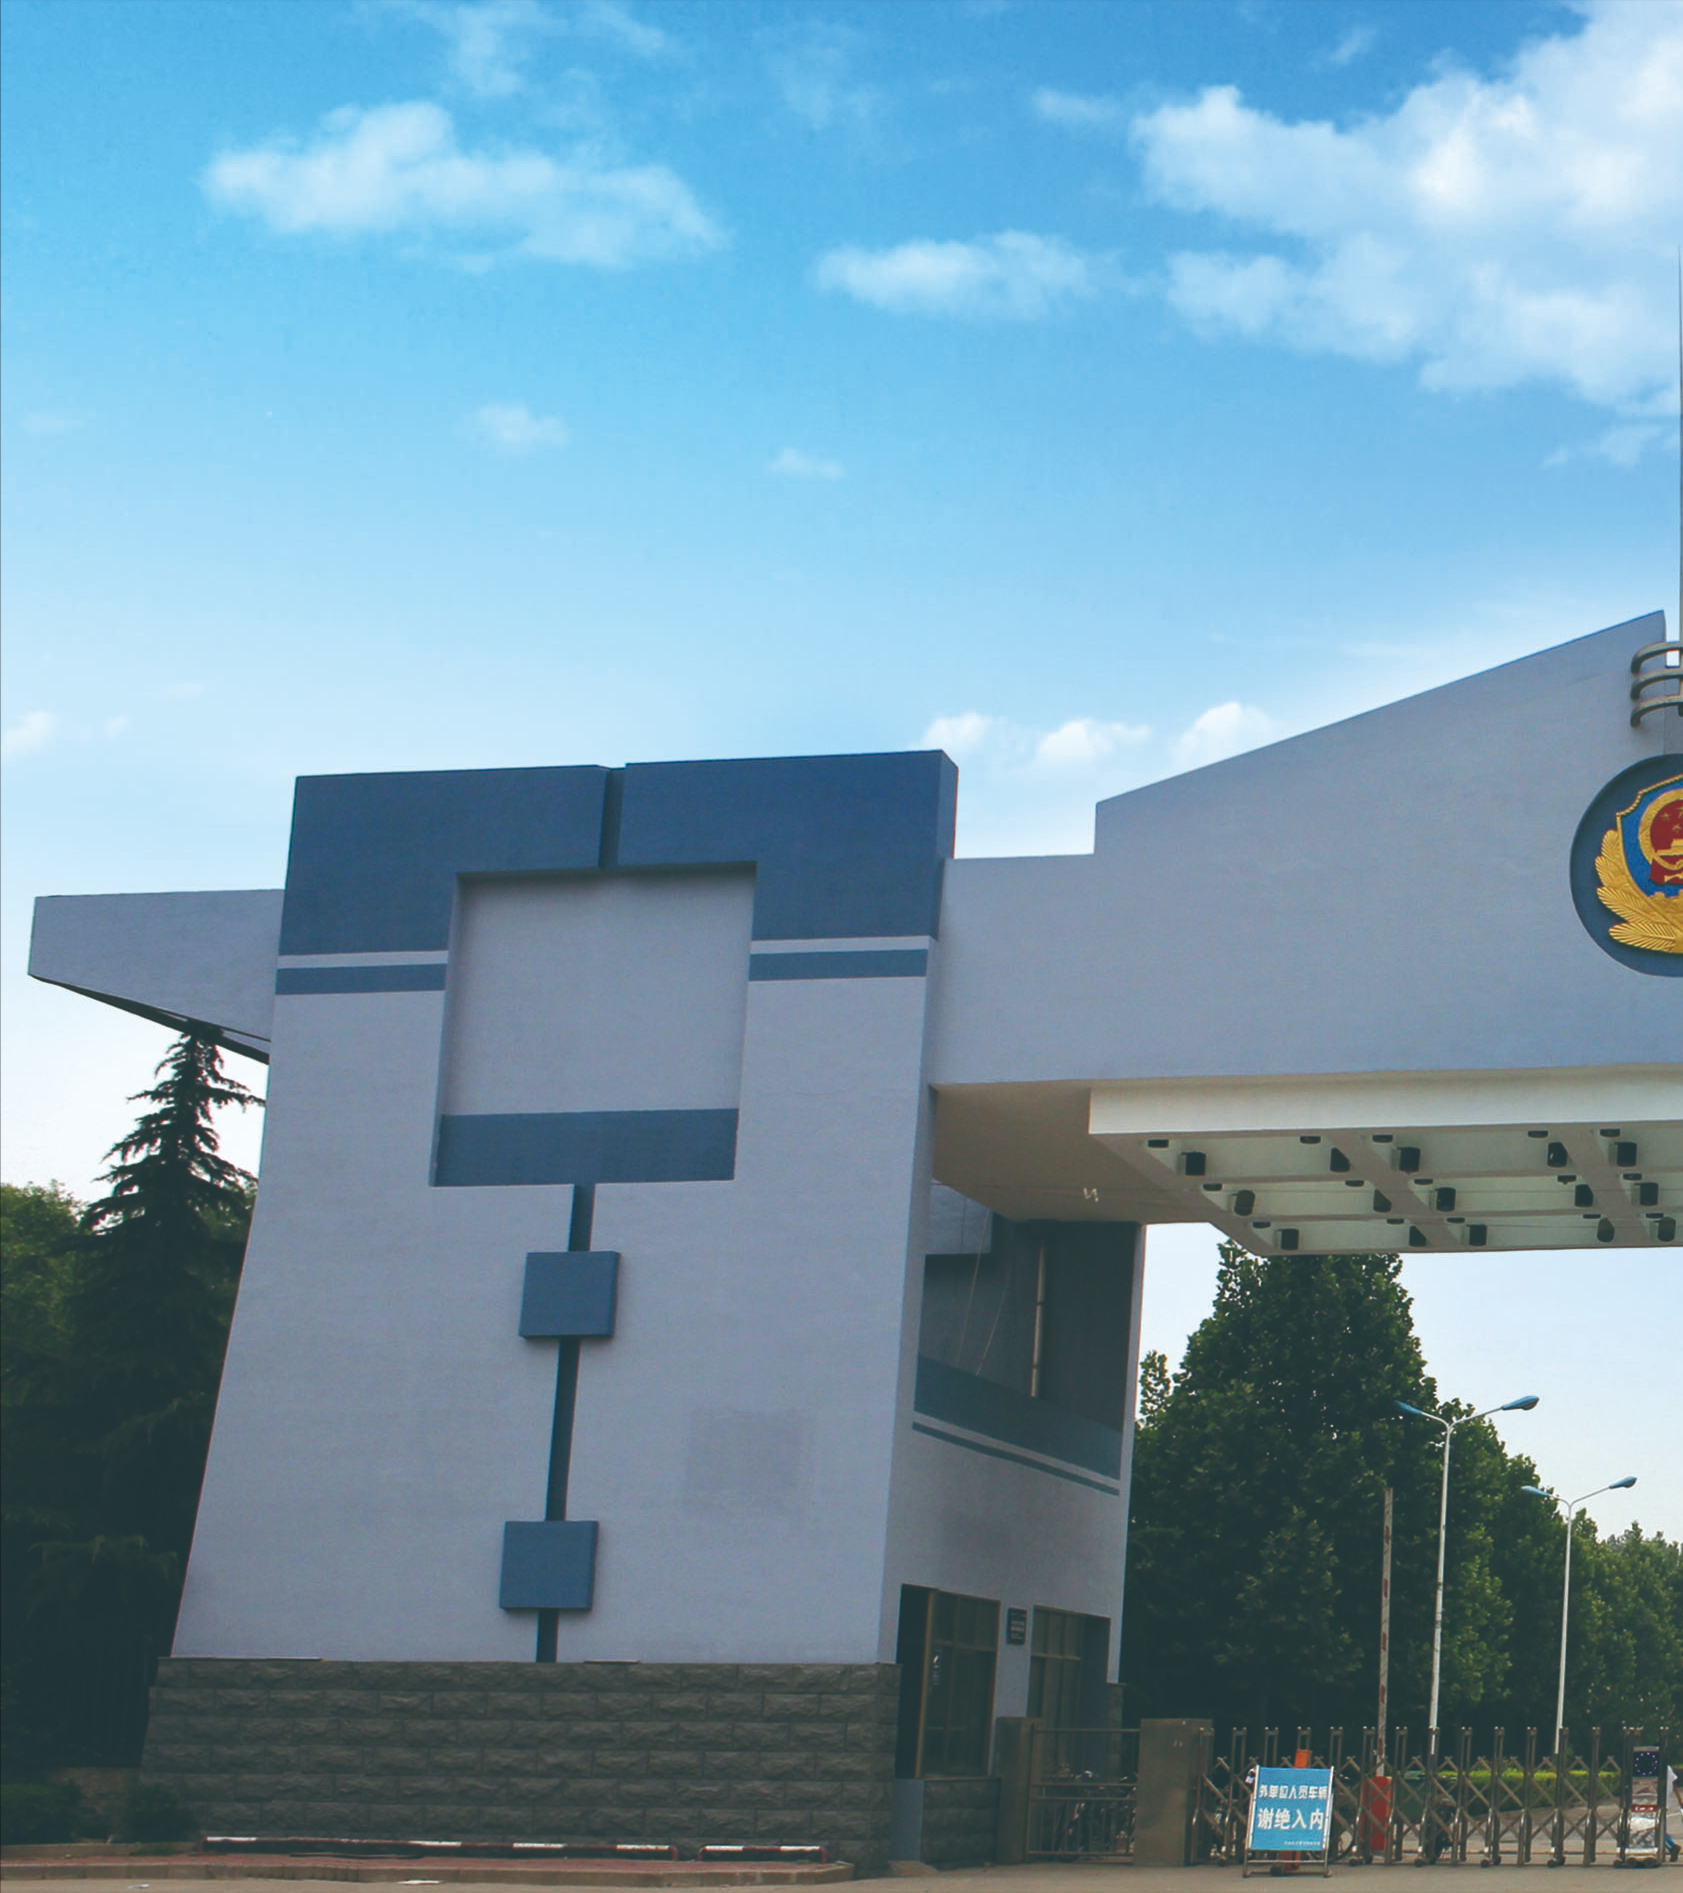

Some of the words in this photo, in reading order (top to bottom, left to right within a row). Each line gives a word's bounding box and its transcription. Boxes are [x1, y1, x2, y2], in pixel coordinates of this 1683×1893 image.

[1258, 1784, 1329, 1800] 外单位人员车辆
[1257, 1807, 1324, 1830] 谢绝入内
